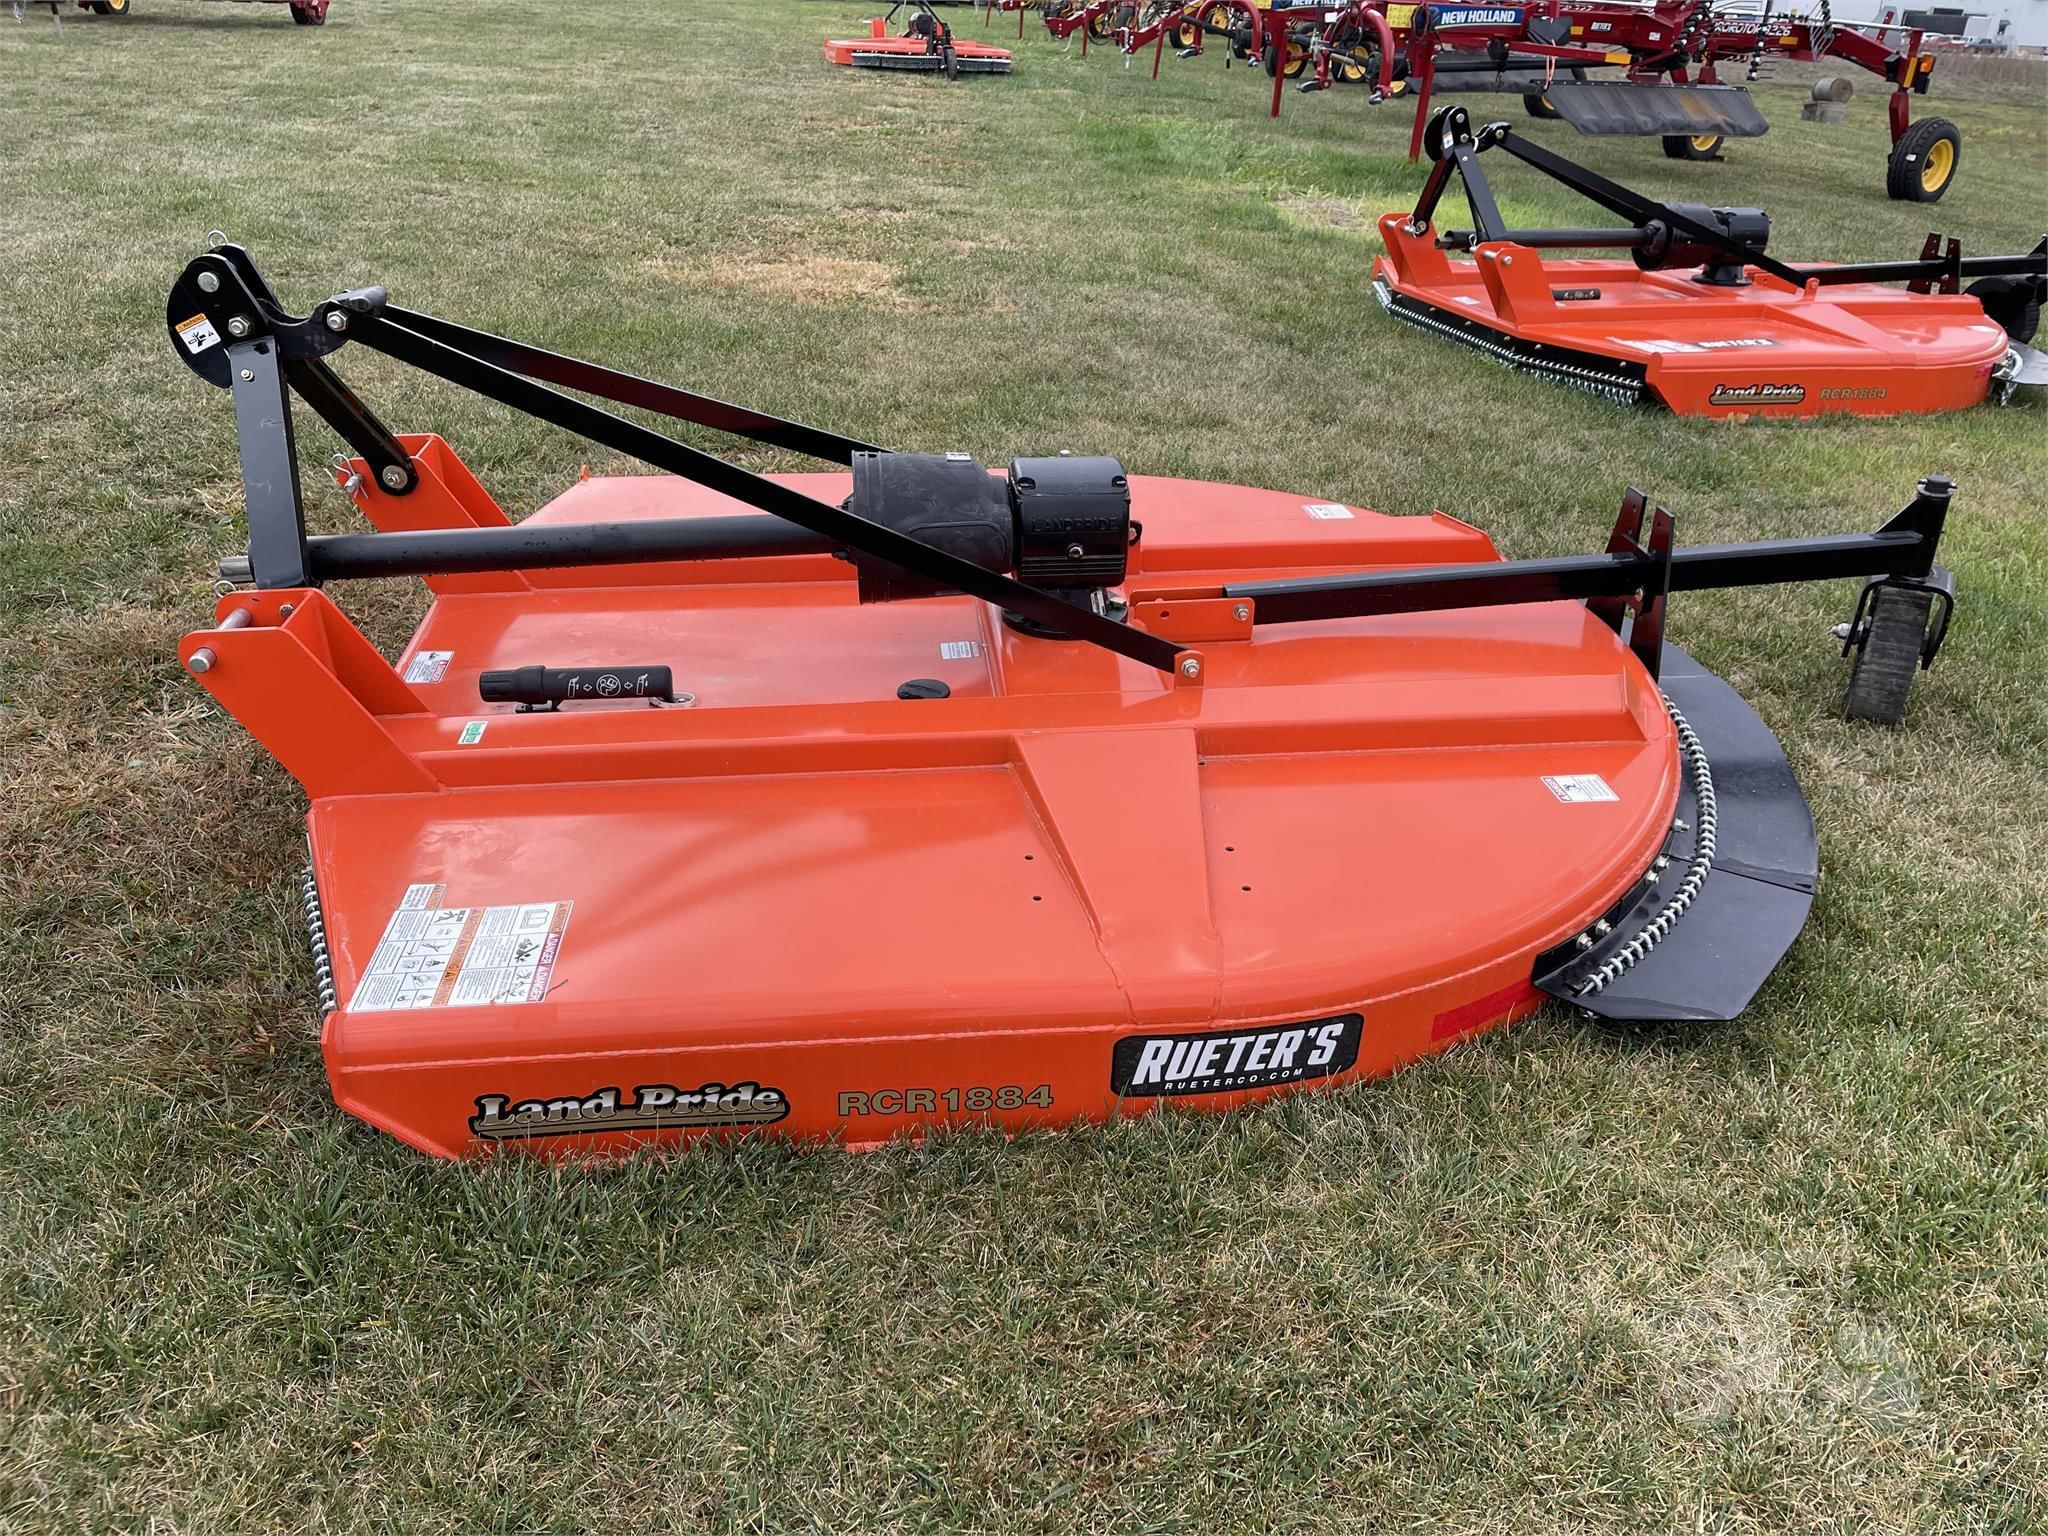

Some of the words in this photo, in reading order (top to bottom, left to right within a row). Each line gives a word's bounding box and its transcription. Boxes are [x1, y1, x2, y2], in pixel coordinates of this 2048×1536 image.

[1441, 10, 1467, 24] NEW
[1468, 10, 1516, 23] HOLLAND
[1715, 384, 1756, 397] Land
[1820, 388, 1887, 400] RCR1884
[1031, 516, 1120, 533] LANDPRIDE
[540, 938, 558, 964] DANGER
[527, 971, 548, 1000] DANGER
[1131, 1022, 1345, 1085] RUETER'S
[1165, 1068, 1304, 1090] RUETERCO.COM
[478, 1089, 618, 1127] Land
[635, 1083, 781, 1117] Pride
[837, 1084, 1054, 1117] RCR1884
